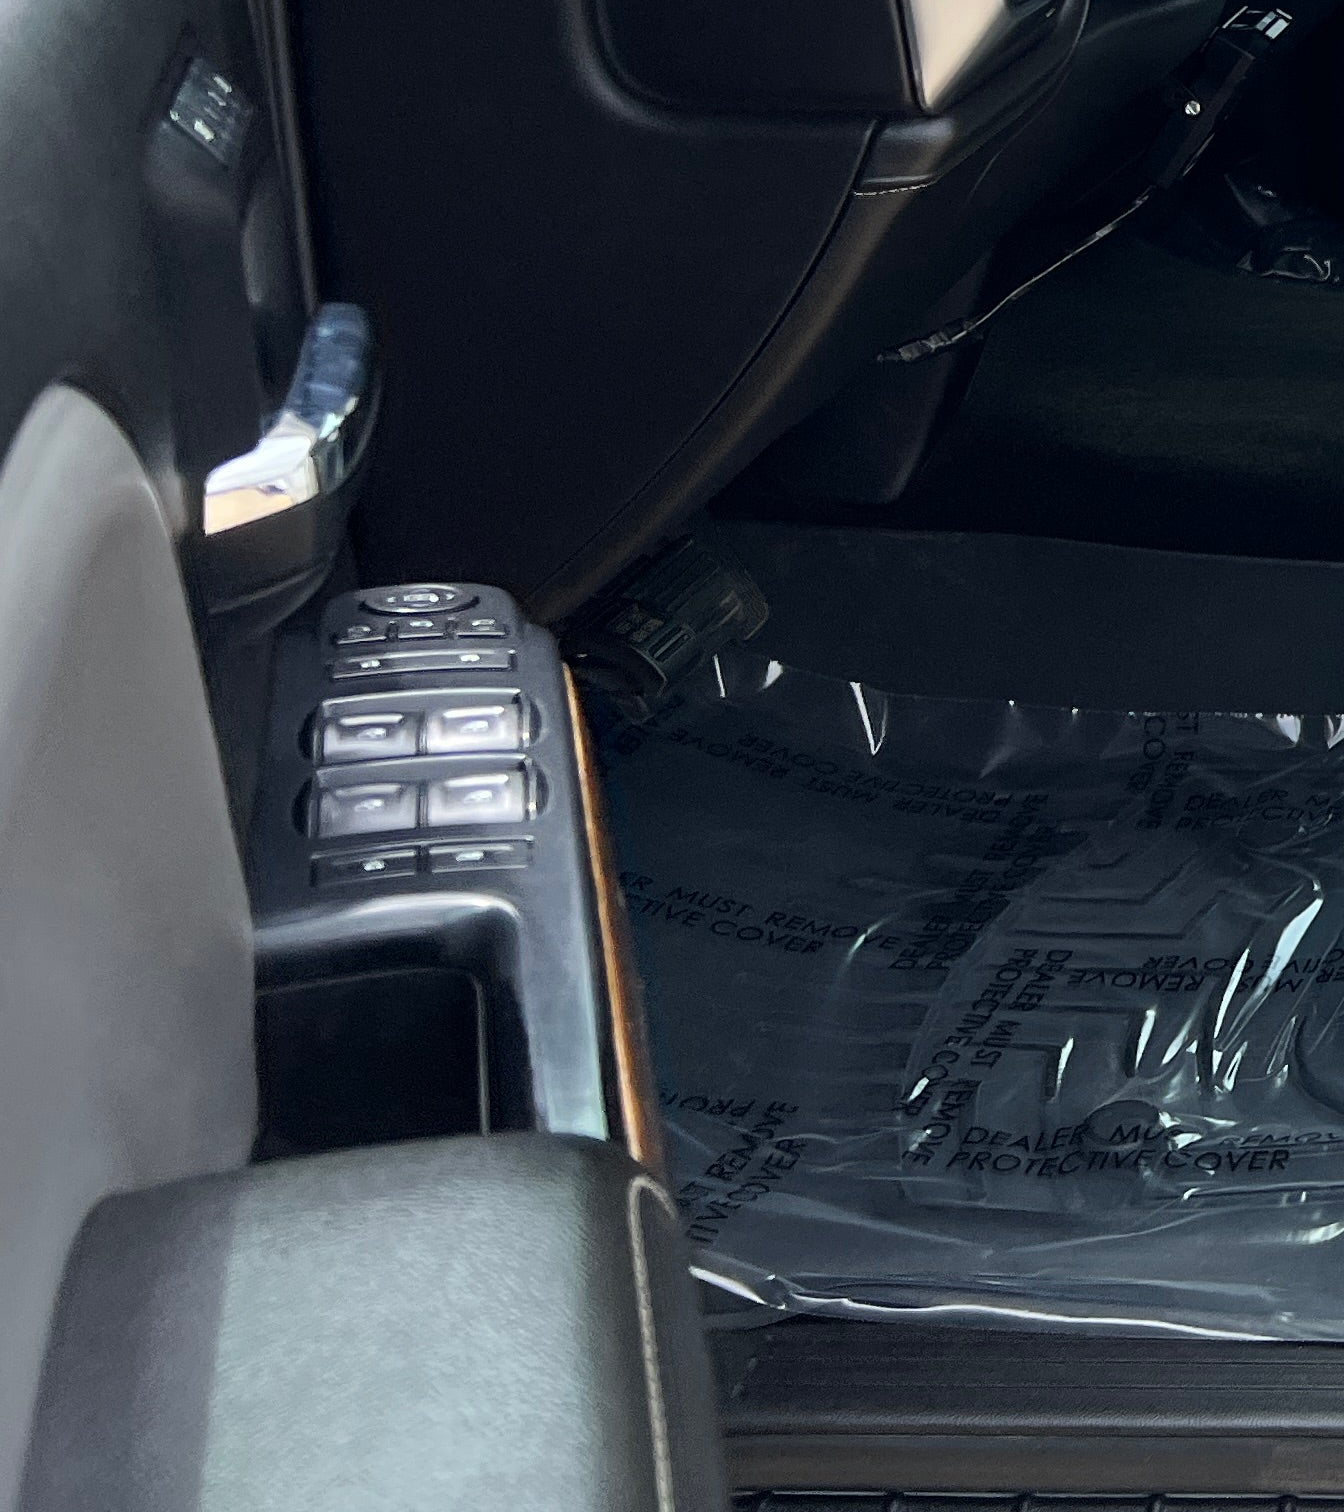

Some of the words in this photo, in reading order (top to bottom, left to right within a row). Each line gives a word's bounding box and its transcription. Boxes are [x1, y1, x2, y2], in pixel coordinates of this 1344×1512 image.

[665, 884, 752, 918] MUST
[763, 909, 902, 951] REMOVE
[709, 918, 826, 957] COVER
[1066, 967, 1207, 993] REMOVE
[970, 1019, 1024, 1070] MUST
[963, 1125, 1087, 1153] DEALER
[946, 1149, 1158, 1178] PROTECTIVE
[1163, 1149, 1292, 1173] COVER
